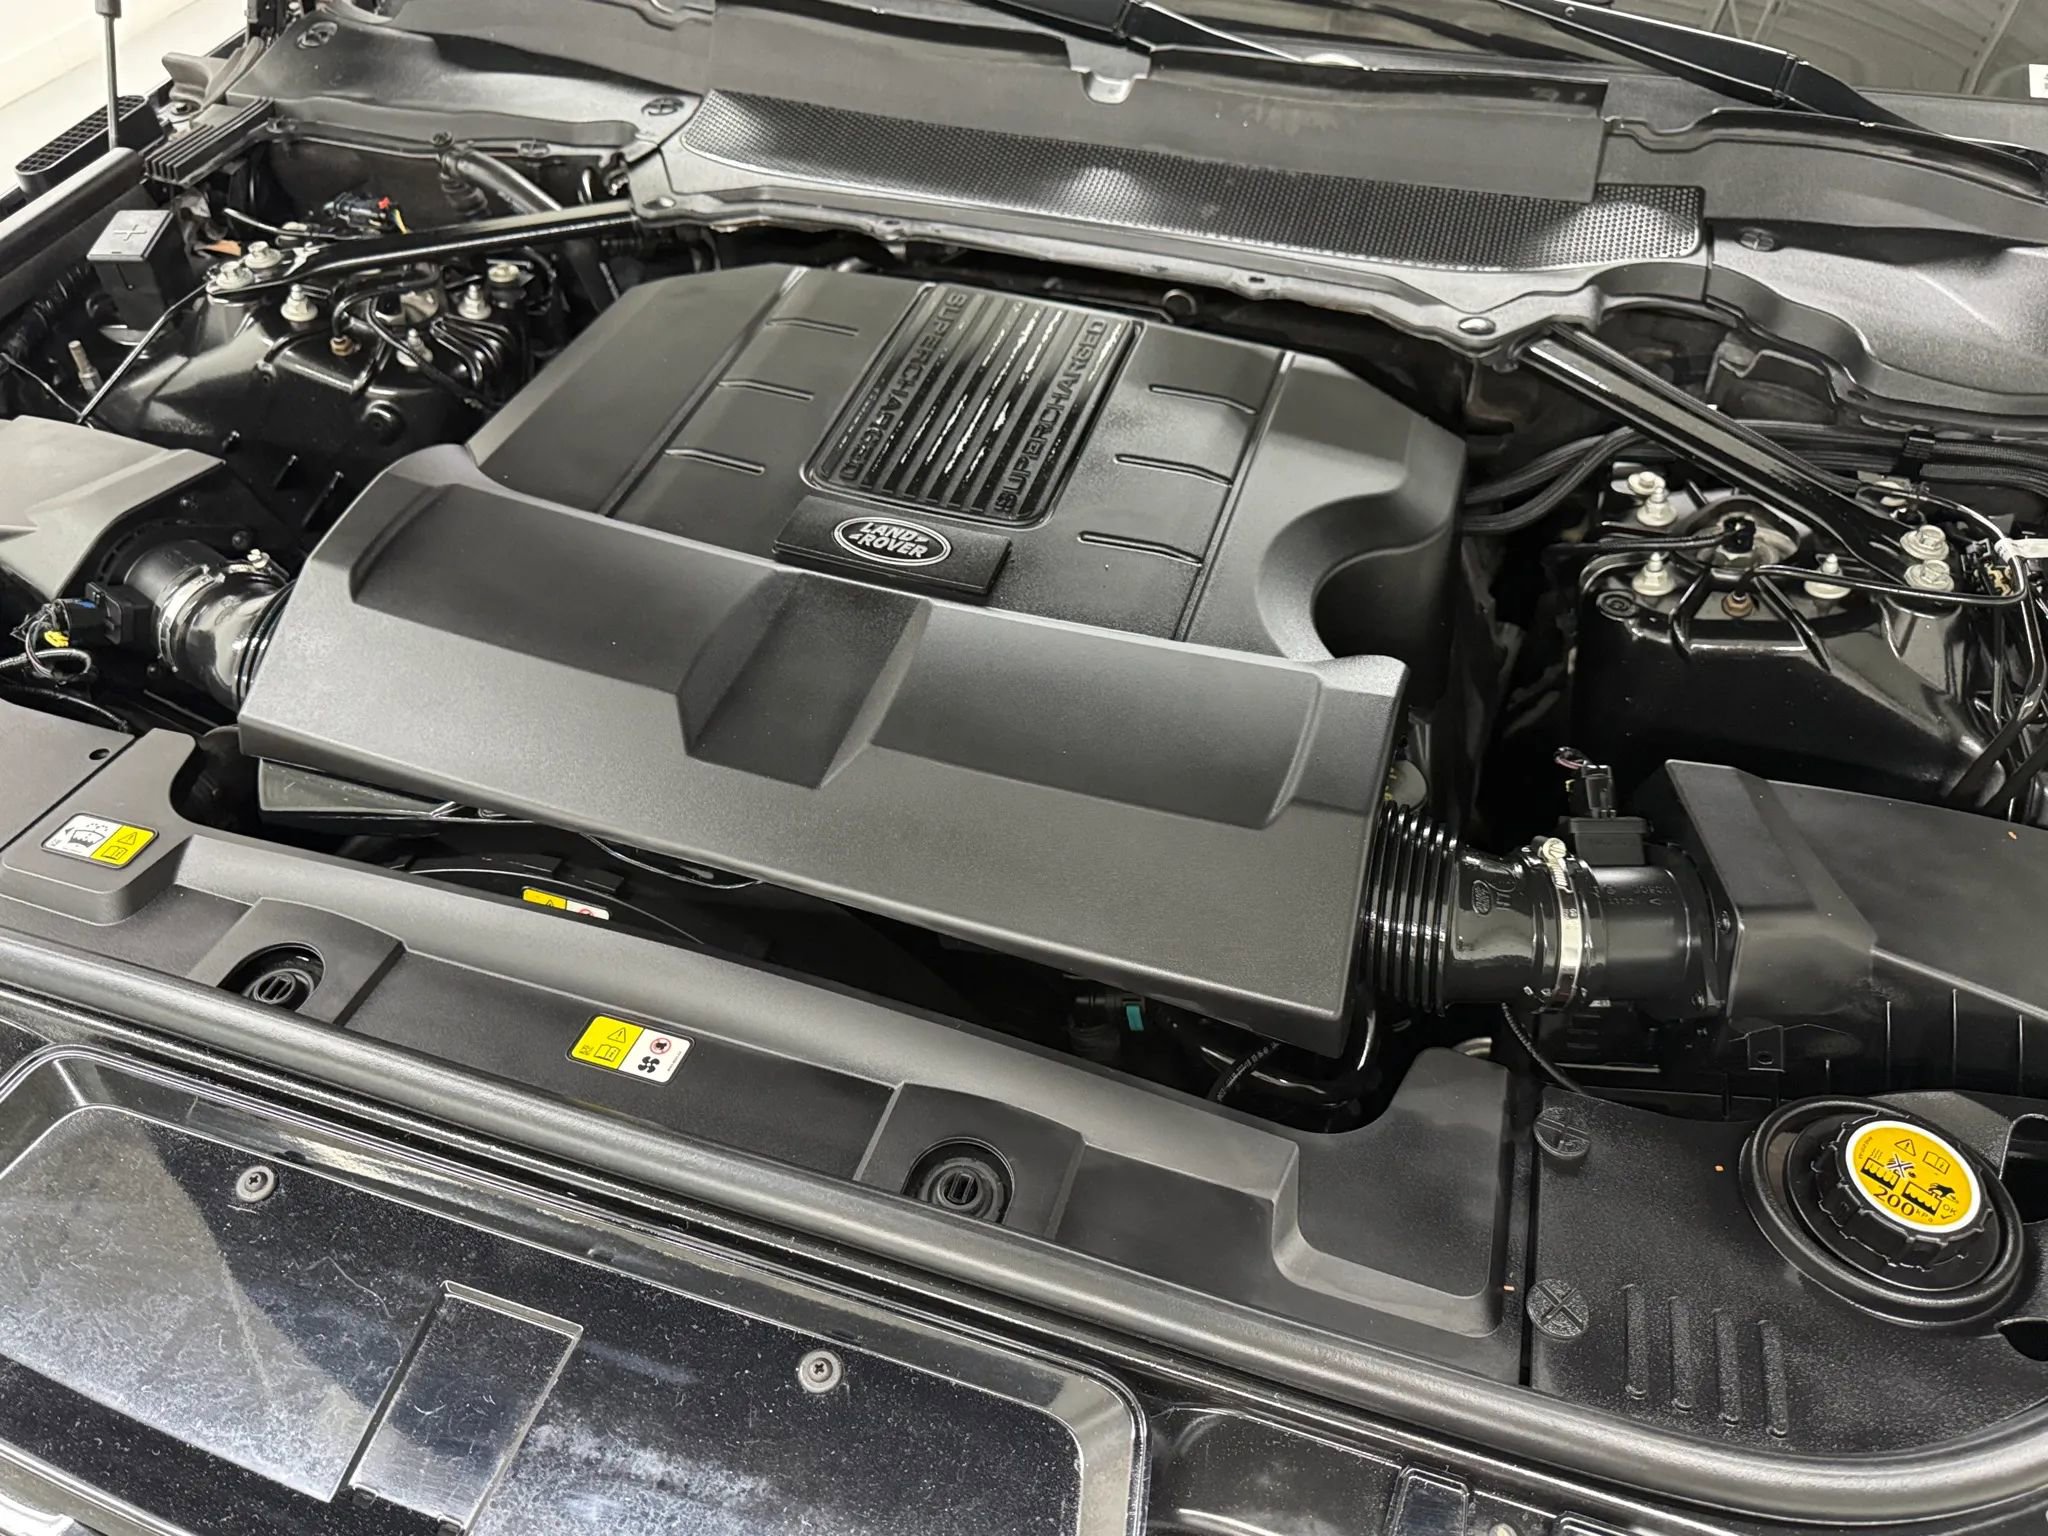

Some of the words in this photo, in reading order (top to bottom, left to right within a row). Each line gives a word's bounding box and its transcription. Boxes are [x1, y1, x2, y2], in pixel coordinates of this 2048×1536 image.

[839, 292, 968, 481] SUPERCHARGED
[994, 320, 1108, 514] SUPERCHARGED
[860, 522, 918, 542] LAND
[857, 534, 928, 558] ROVER
[1873, 1186, 1915, 1216] 200
[1942, 1204, 1957, 1216] OK
